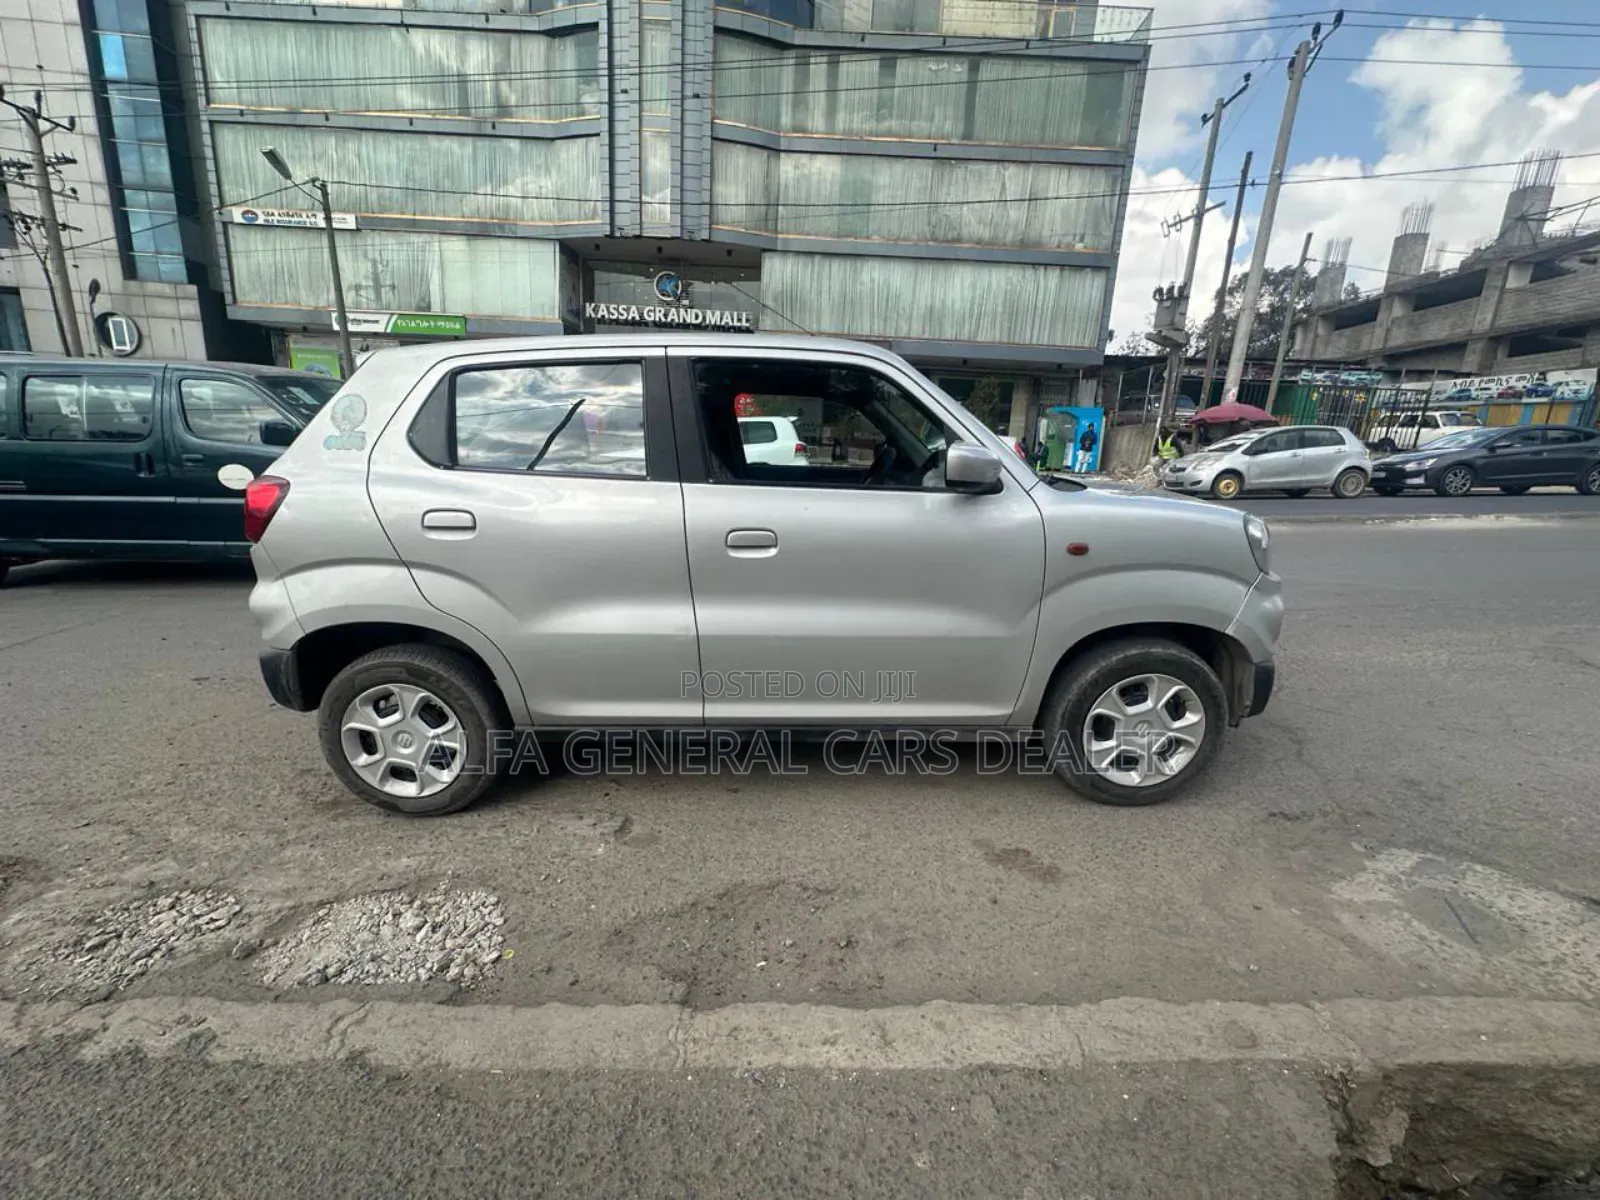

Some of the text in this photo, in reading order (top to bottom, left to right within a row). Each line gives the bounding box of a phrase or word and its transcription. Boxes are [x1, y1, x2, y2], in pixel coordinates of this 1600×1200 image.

[586, 302, 750, 326] KASSA GRAND MALL
